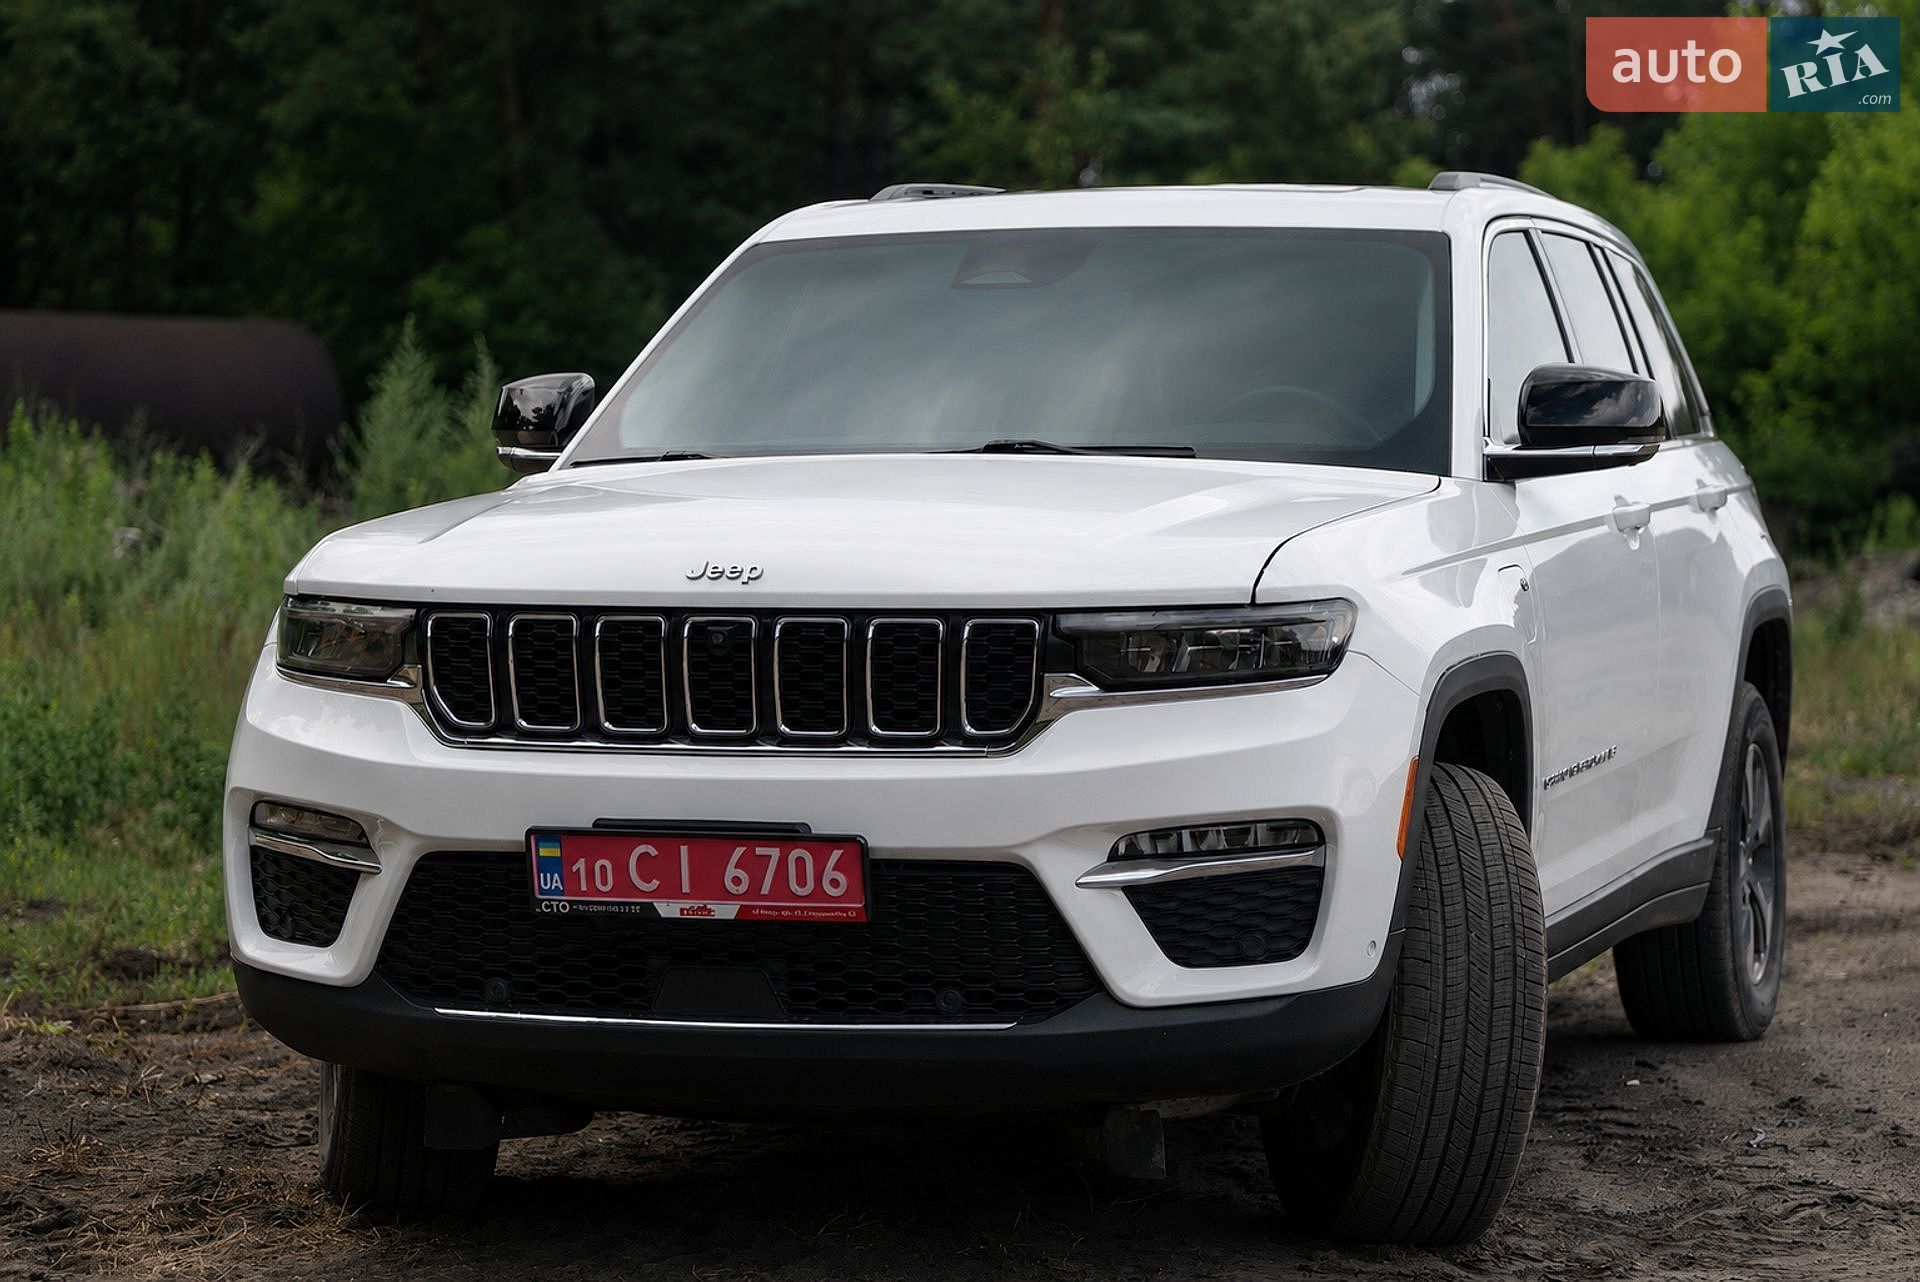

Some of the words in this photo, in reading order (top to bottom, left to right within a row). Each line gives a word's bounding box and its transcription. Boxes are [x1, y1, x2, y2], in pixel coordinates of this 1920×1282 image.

[685, 560, 765, 586] Jeep
[540, 872, 563, 891] UA
[571, 857, 614, 893] 10
[723, 846, 849, 897] 6706
